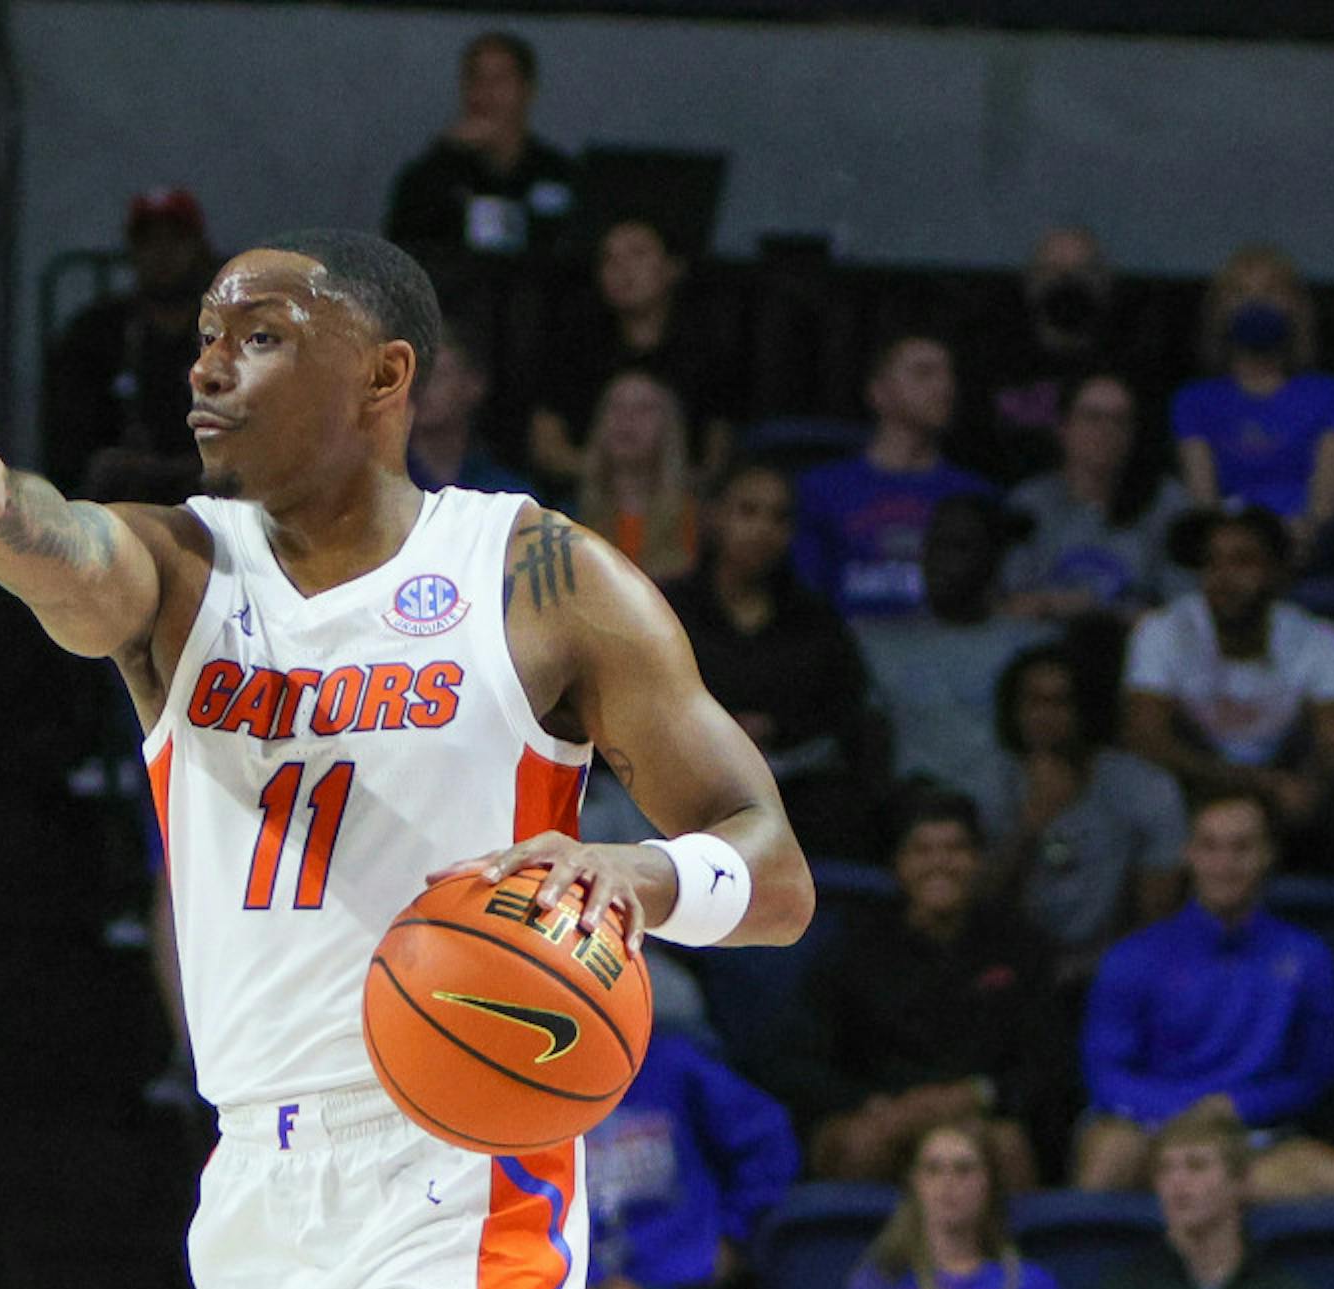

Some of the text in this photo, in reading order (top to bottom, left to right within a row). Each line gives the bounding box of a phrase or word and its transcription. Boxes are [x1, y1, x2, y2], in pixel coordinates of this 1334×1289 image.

[398, 577, 454, 619] SEC
[187, 658, 464, 740] GATORS
[243, 760, 355, 910] 11
[278, 1103, 299, 1150] F
